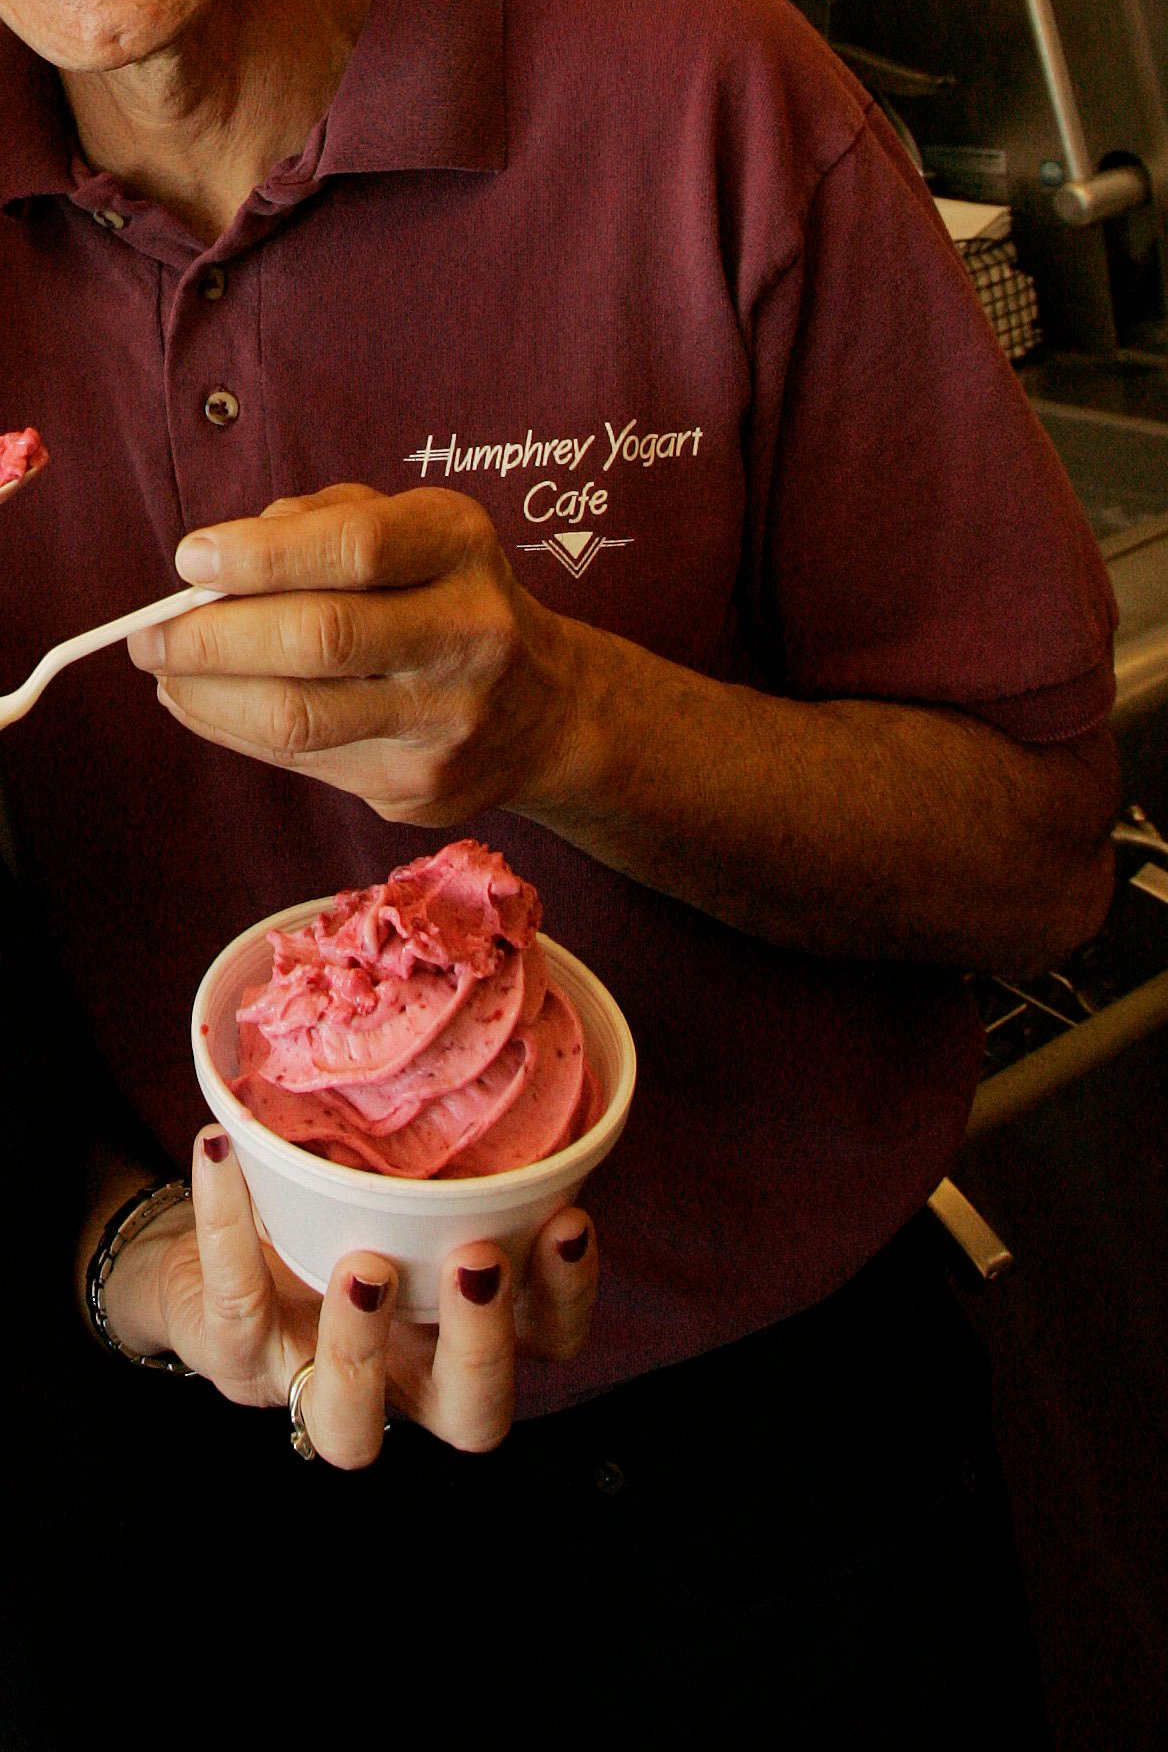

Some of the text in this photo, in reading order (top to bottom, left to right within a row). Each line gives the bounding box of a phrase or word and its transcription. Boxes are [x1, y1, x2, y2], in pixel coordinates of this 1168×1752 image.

[403, 418, 703, 477] Humphrey Yogart
[523, 480, 609, 523] Cafe
